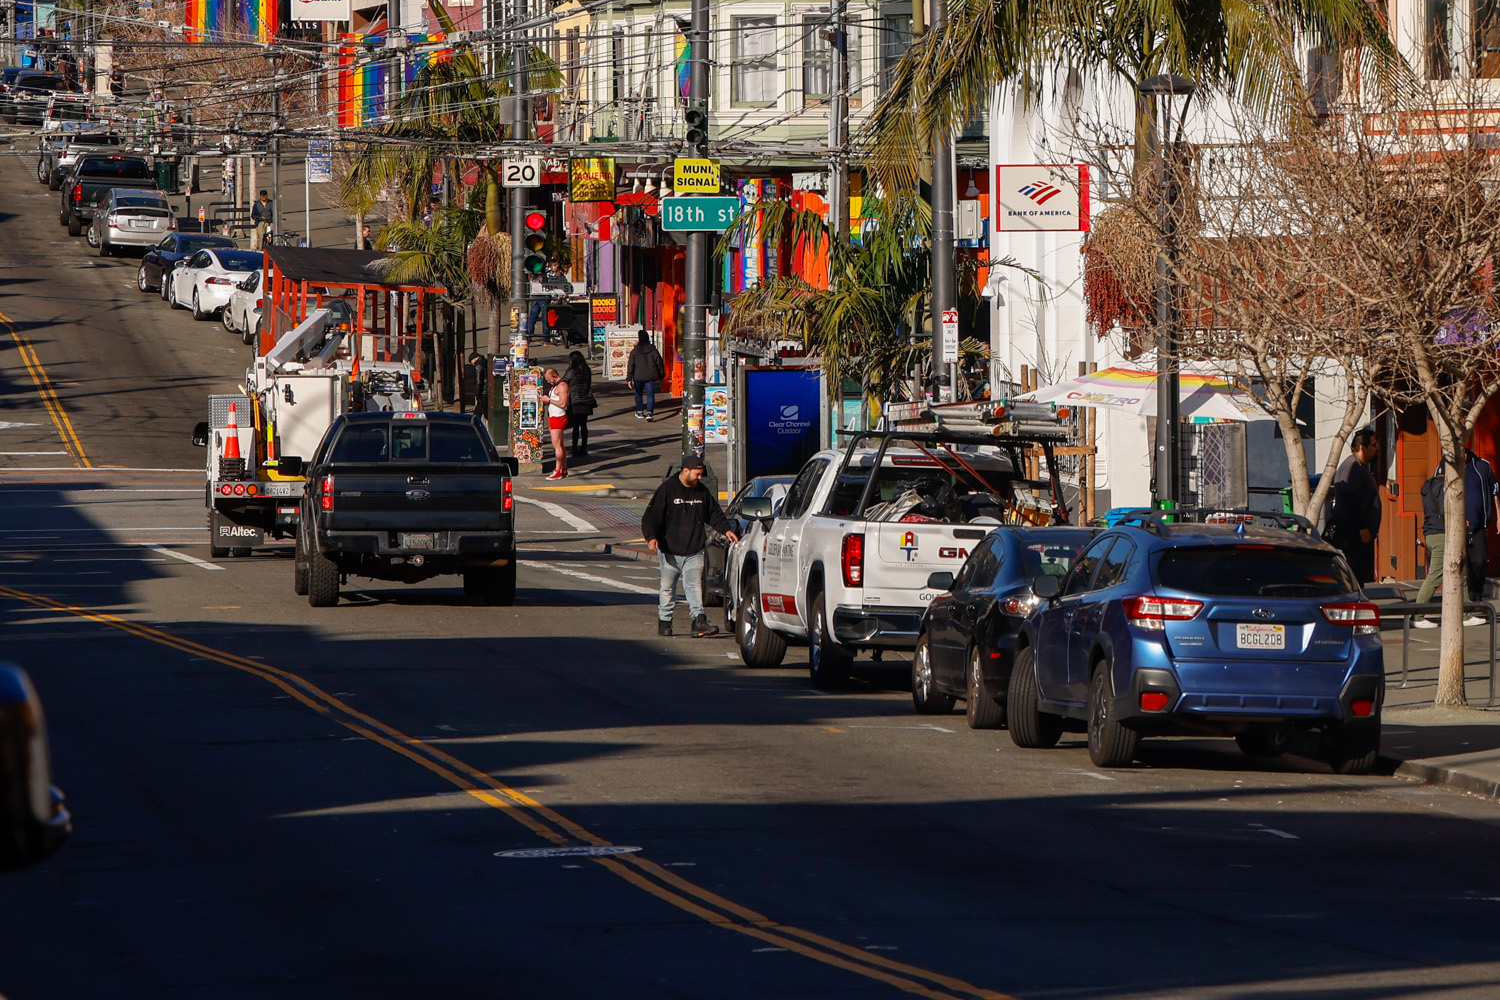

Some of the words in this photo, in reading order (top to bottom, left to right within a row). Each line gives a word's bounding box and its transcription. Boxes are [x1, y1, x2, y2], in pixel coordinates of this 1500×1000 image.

[282, 22, 318, 30] NAILS
[507, 165, 535, 181] 20
[683, 165, 712, 173] MUNI
[573, 172, 613, 180] TAQUERIA
[677, 177, 717, 186] SIGNAL
[668, 206, 705, 222] 18th
[718, 206, 735, 222] st
[1066, 391, 1141, 405] CASTRO
[768, 420, 785, 428] Clear
[785, 420, 811, 428] Channel
[777, 427, 802, 435] Outdoor
[230, 526, 256, 537] Altec
